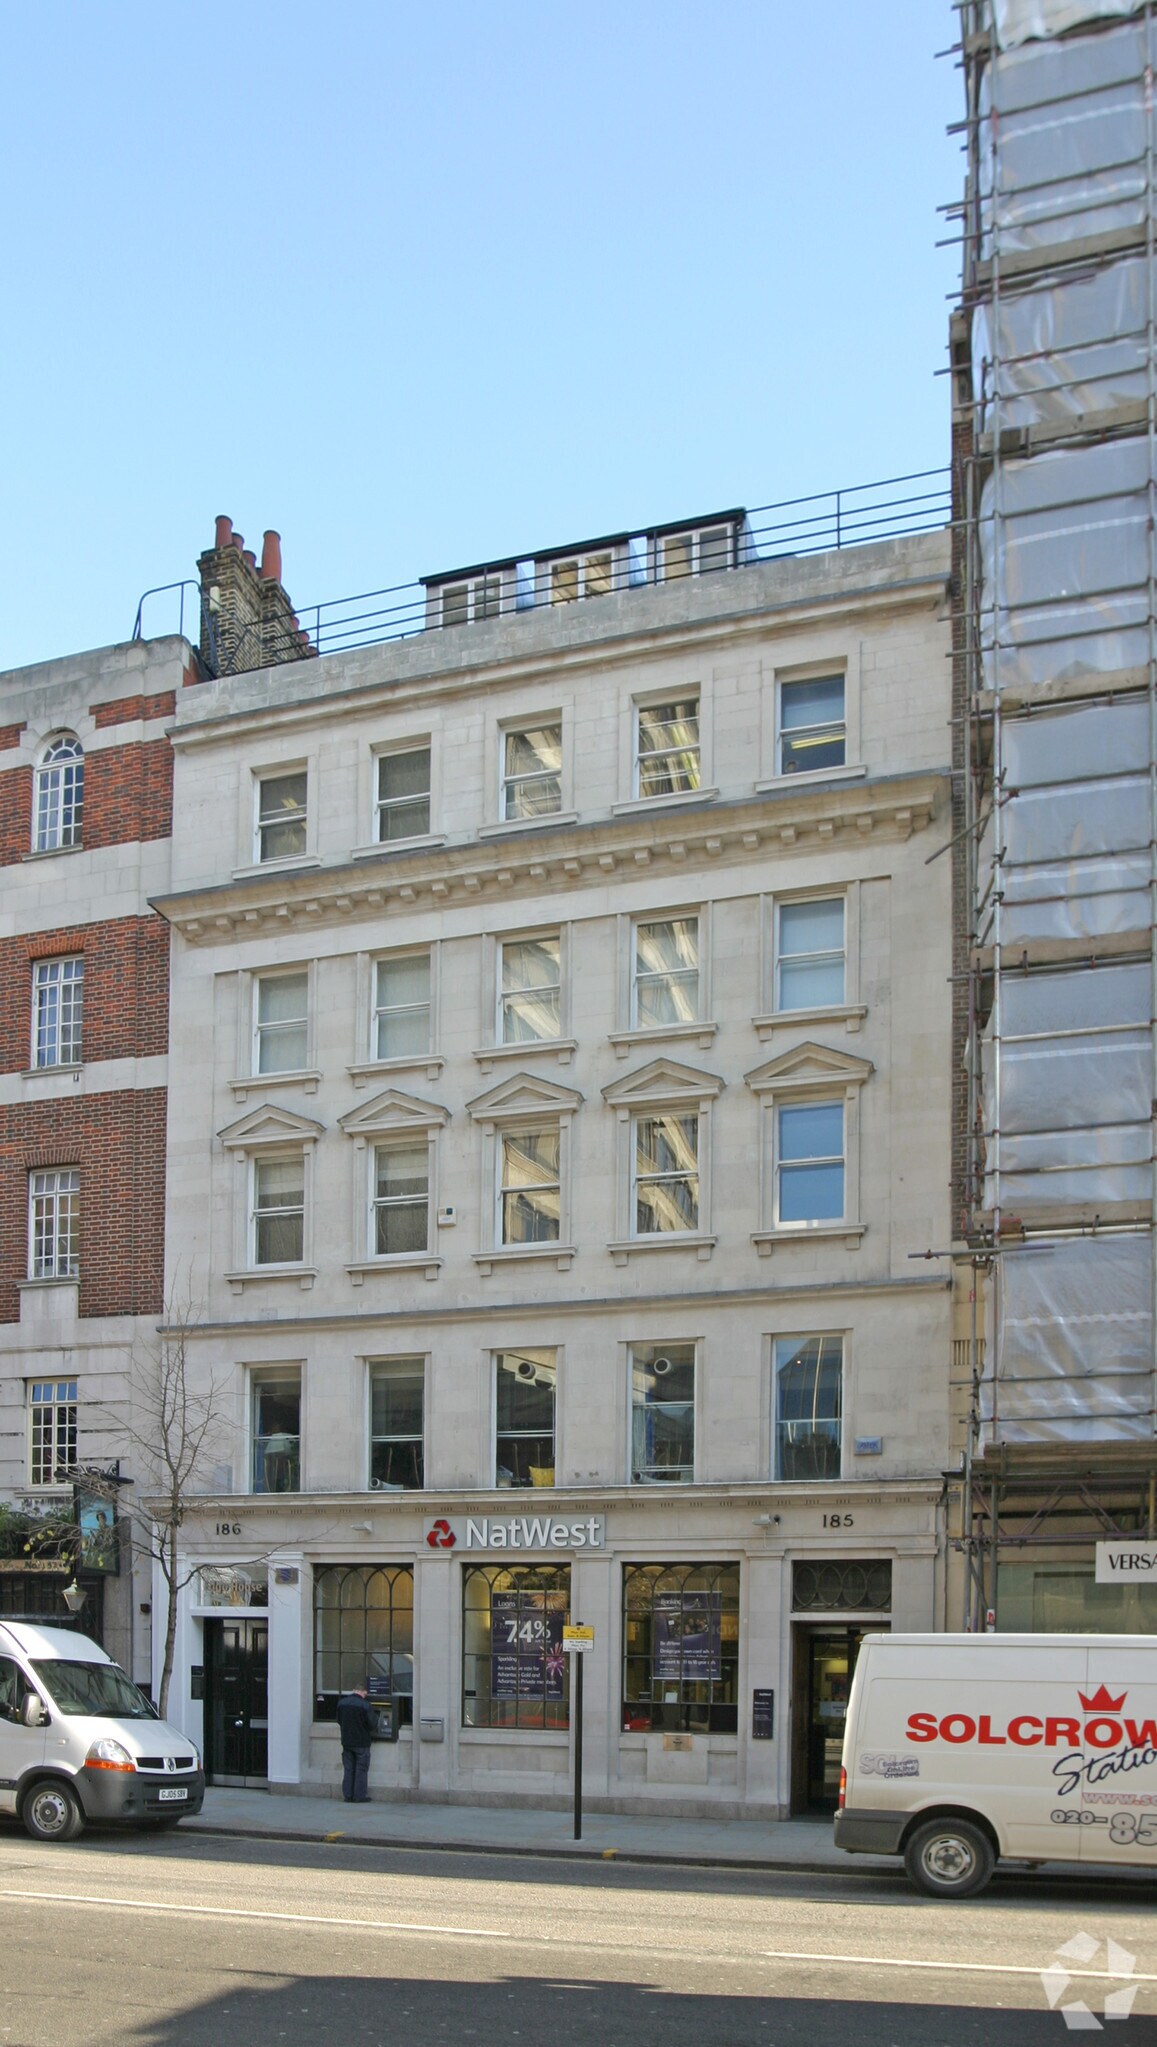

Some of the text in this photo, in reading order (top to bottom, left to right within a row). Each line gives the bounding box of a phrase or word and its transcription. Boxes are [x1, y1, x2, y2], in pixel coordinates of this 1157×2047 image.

[215, 1523, 242, 1536] 186
[466, 1516, 601, 1547] NatWest
[822, 1513, 854, 1528] 185
[905, 1713, 1157, 1750] SOLCROW
